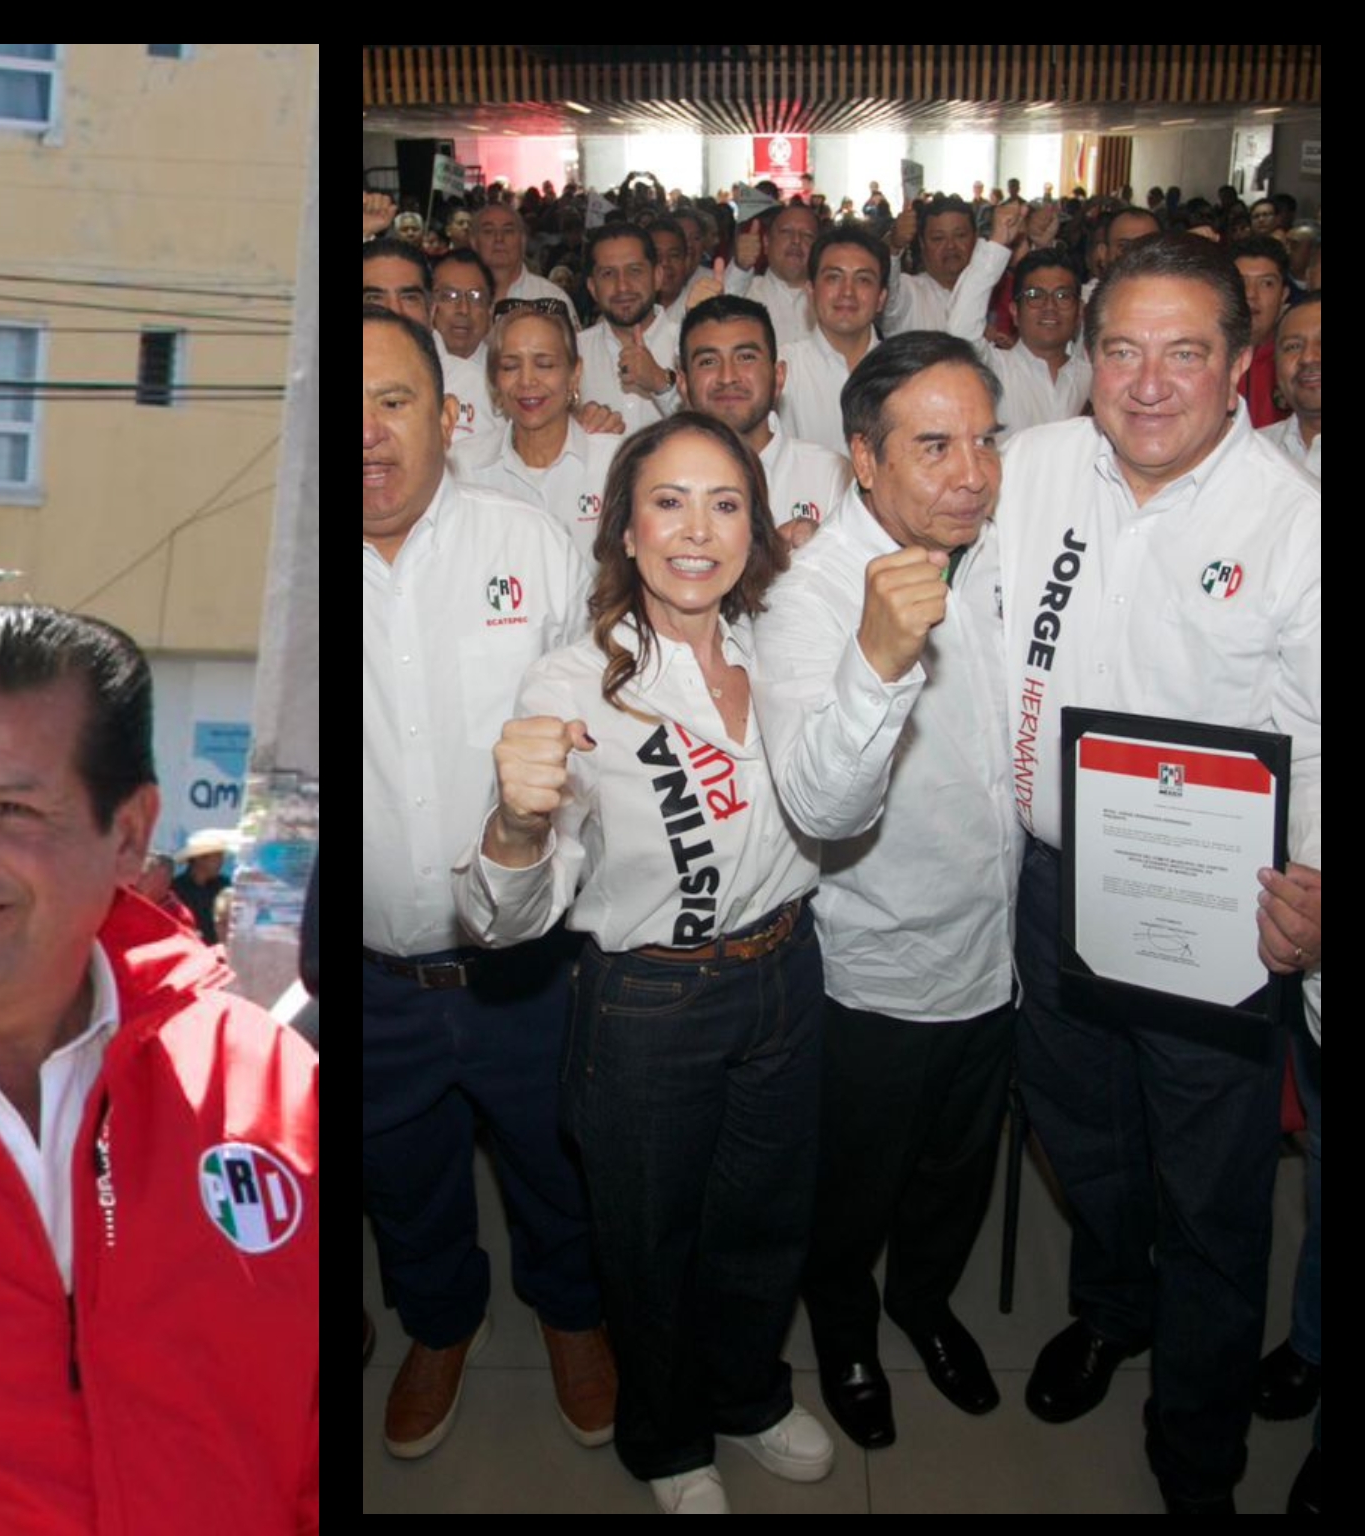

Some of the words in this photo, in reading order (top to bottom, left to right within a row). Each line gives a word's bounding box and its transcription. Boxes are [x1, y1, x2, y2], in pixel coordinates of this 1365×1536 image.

[487, 577, 522, 606] PRI
[1026, 528, 1087, 672] JORGE
[1201, 563, 1241, 595] PRI
[200, 1155, 293, 1229] PRI
